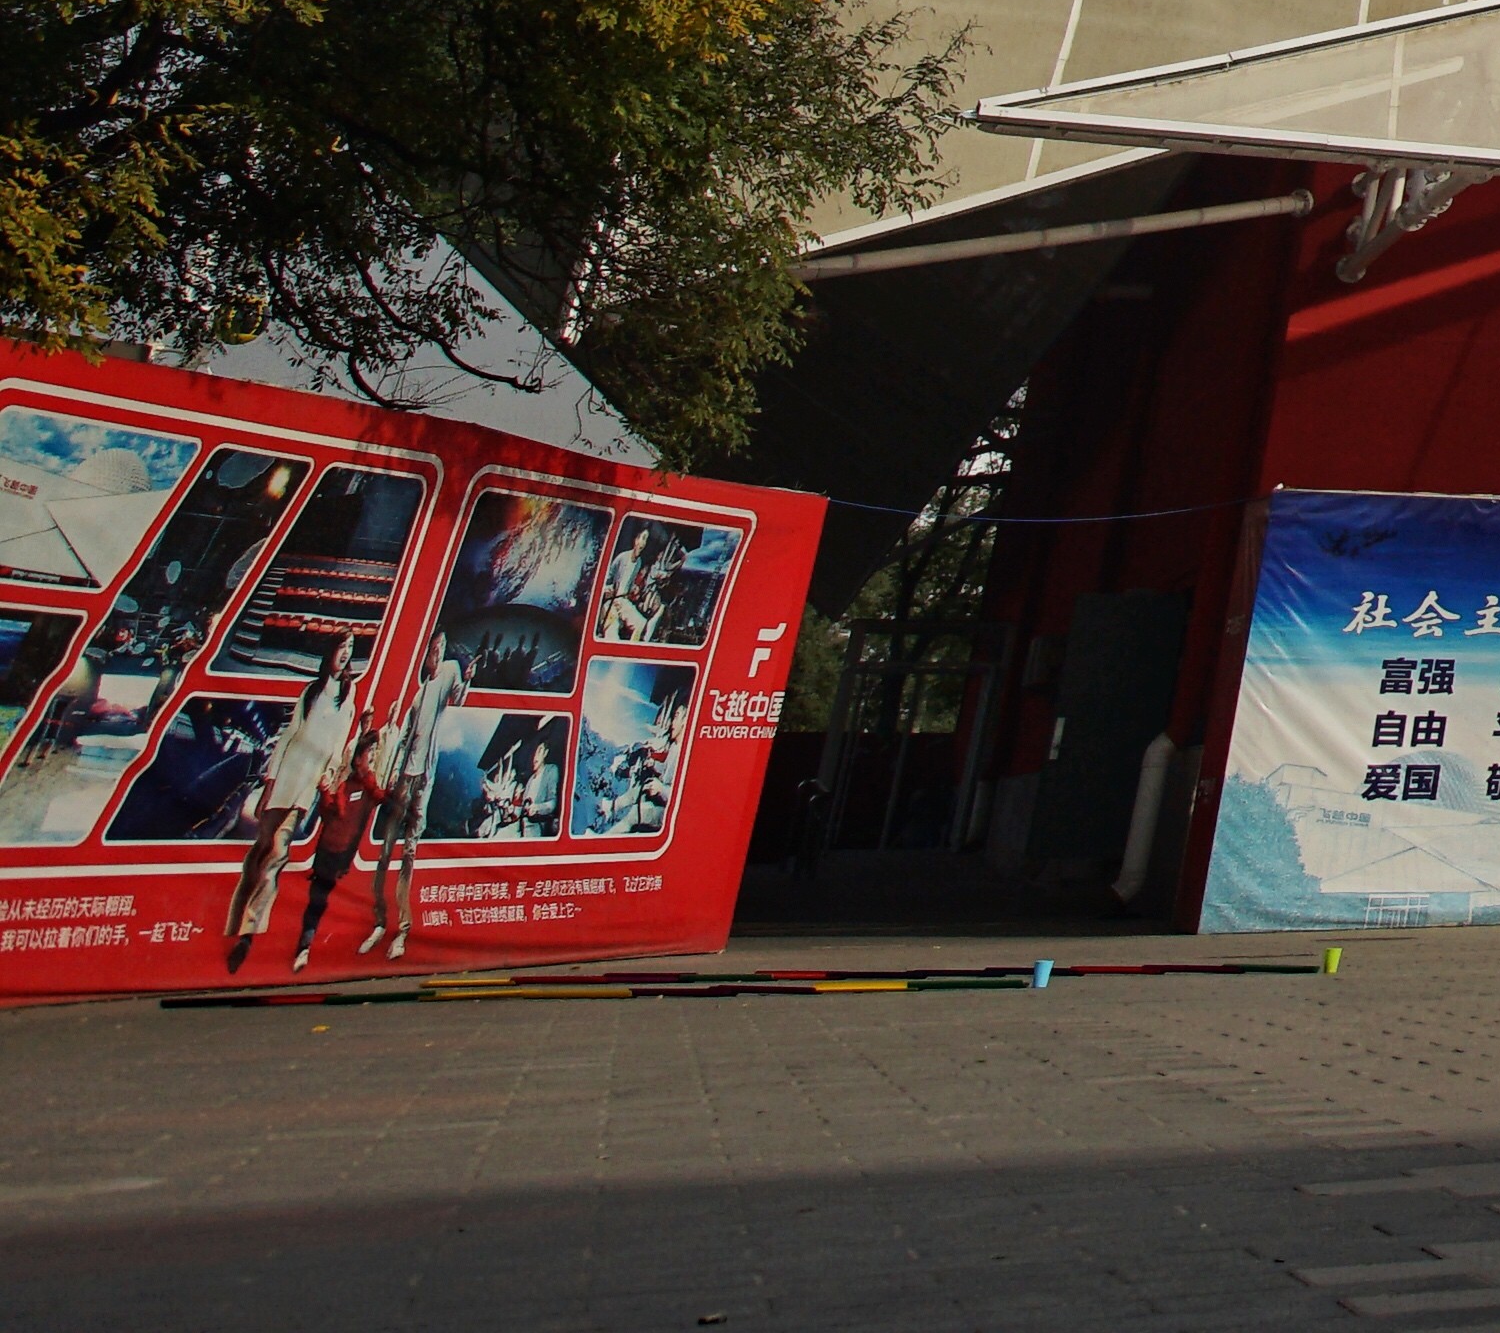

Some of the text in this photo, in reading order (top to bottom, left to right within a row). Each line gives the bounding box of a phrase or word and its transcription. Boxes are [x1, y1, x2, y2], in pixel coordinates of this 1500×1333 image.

[1380, 657, 1455, 695] 富强
[709, 690, 786, 723] 飞越中国
[699, 725, 749, 739] FLYOVER
[1372, 710, 1447, 747] 自由
[1362, 764, 1441, 801] 爱国
